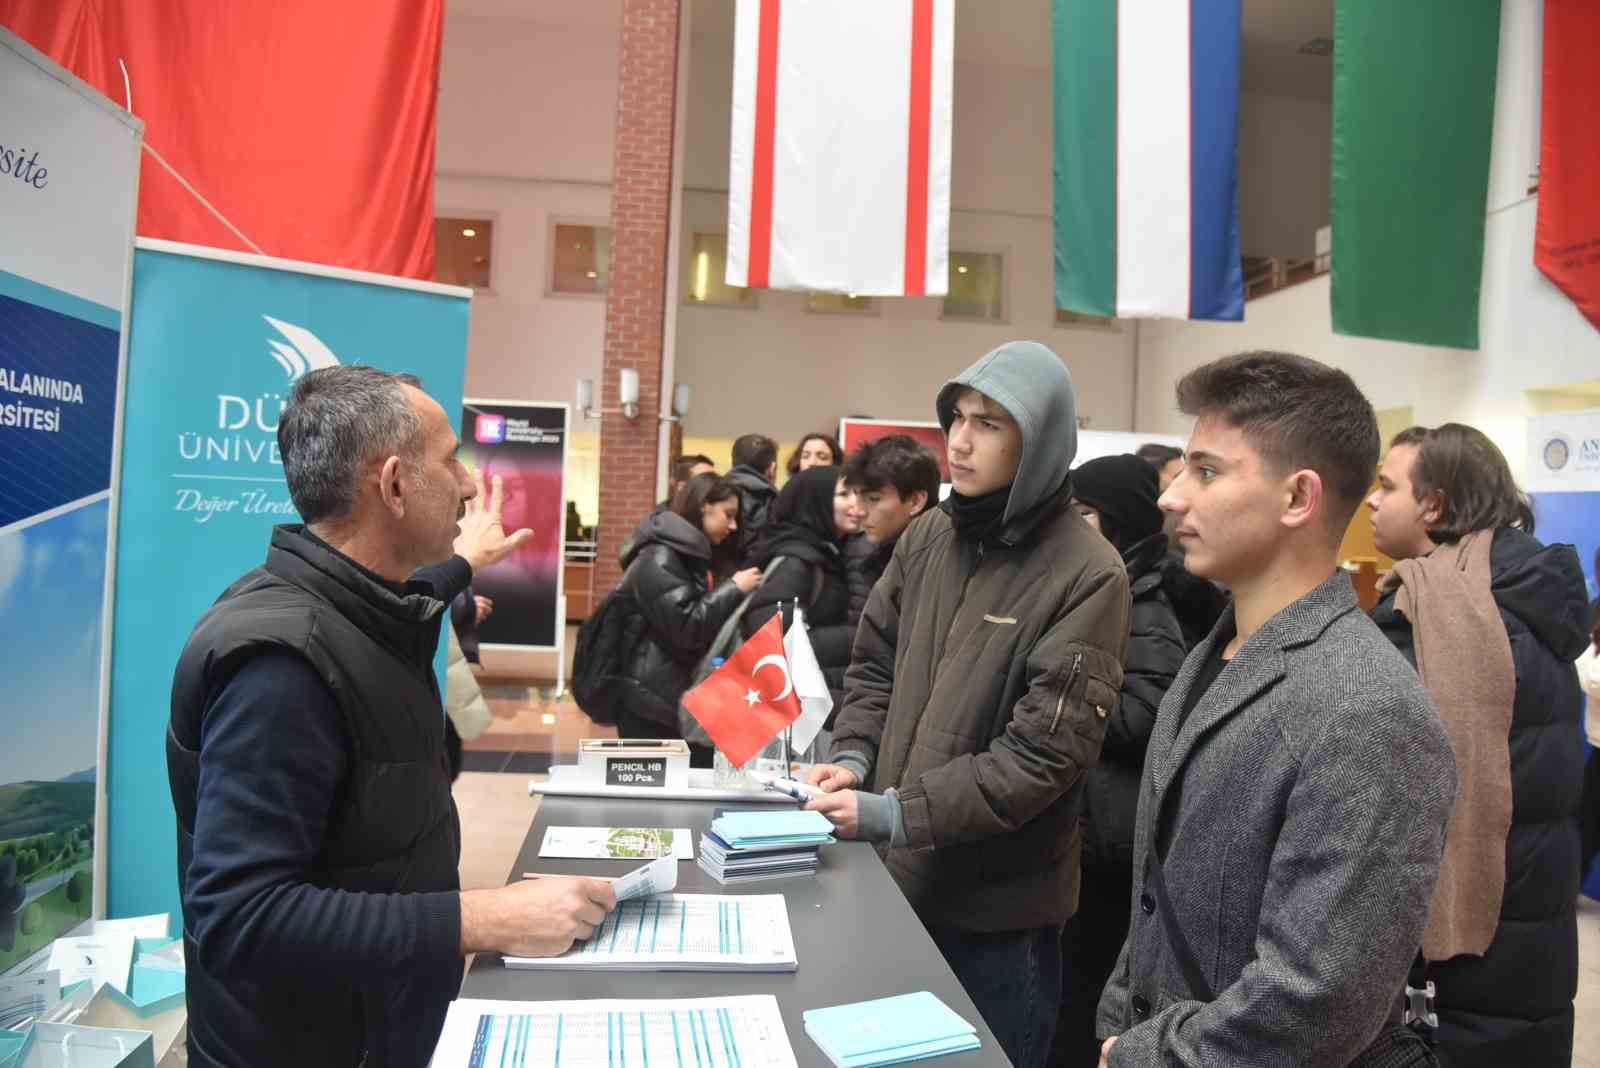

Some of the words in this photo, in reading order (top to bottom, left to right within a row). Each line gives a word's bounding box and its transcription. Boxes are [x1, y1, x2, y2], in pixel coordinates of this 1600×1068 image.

[0, 145, 48, 189] site
[0, 368, 83, 404] ALANINDA
[218, 393, 287, 432] DÜ
[178, 431, 283, 464] ÜNİVE
[1581, 439, 1600, 451] AN
[175, 488, 239, 523] Değer
[611, 762, 646, 771] PENCIL
[647, 762, 662, 771] HB
[618, 774, 634, 782] 100
